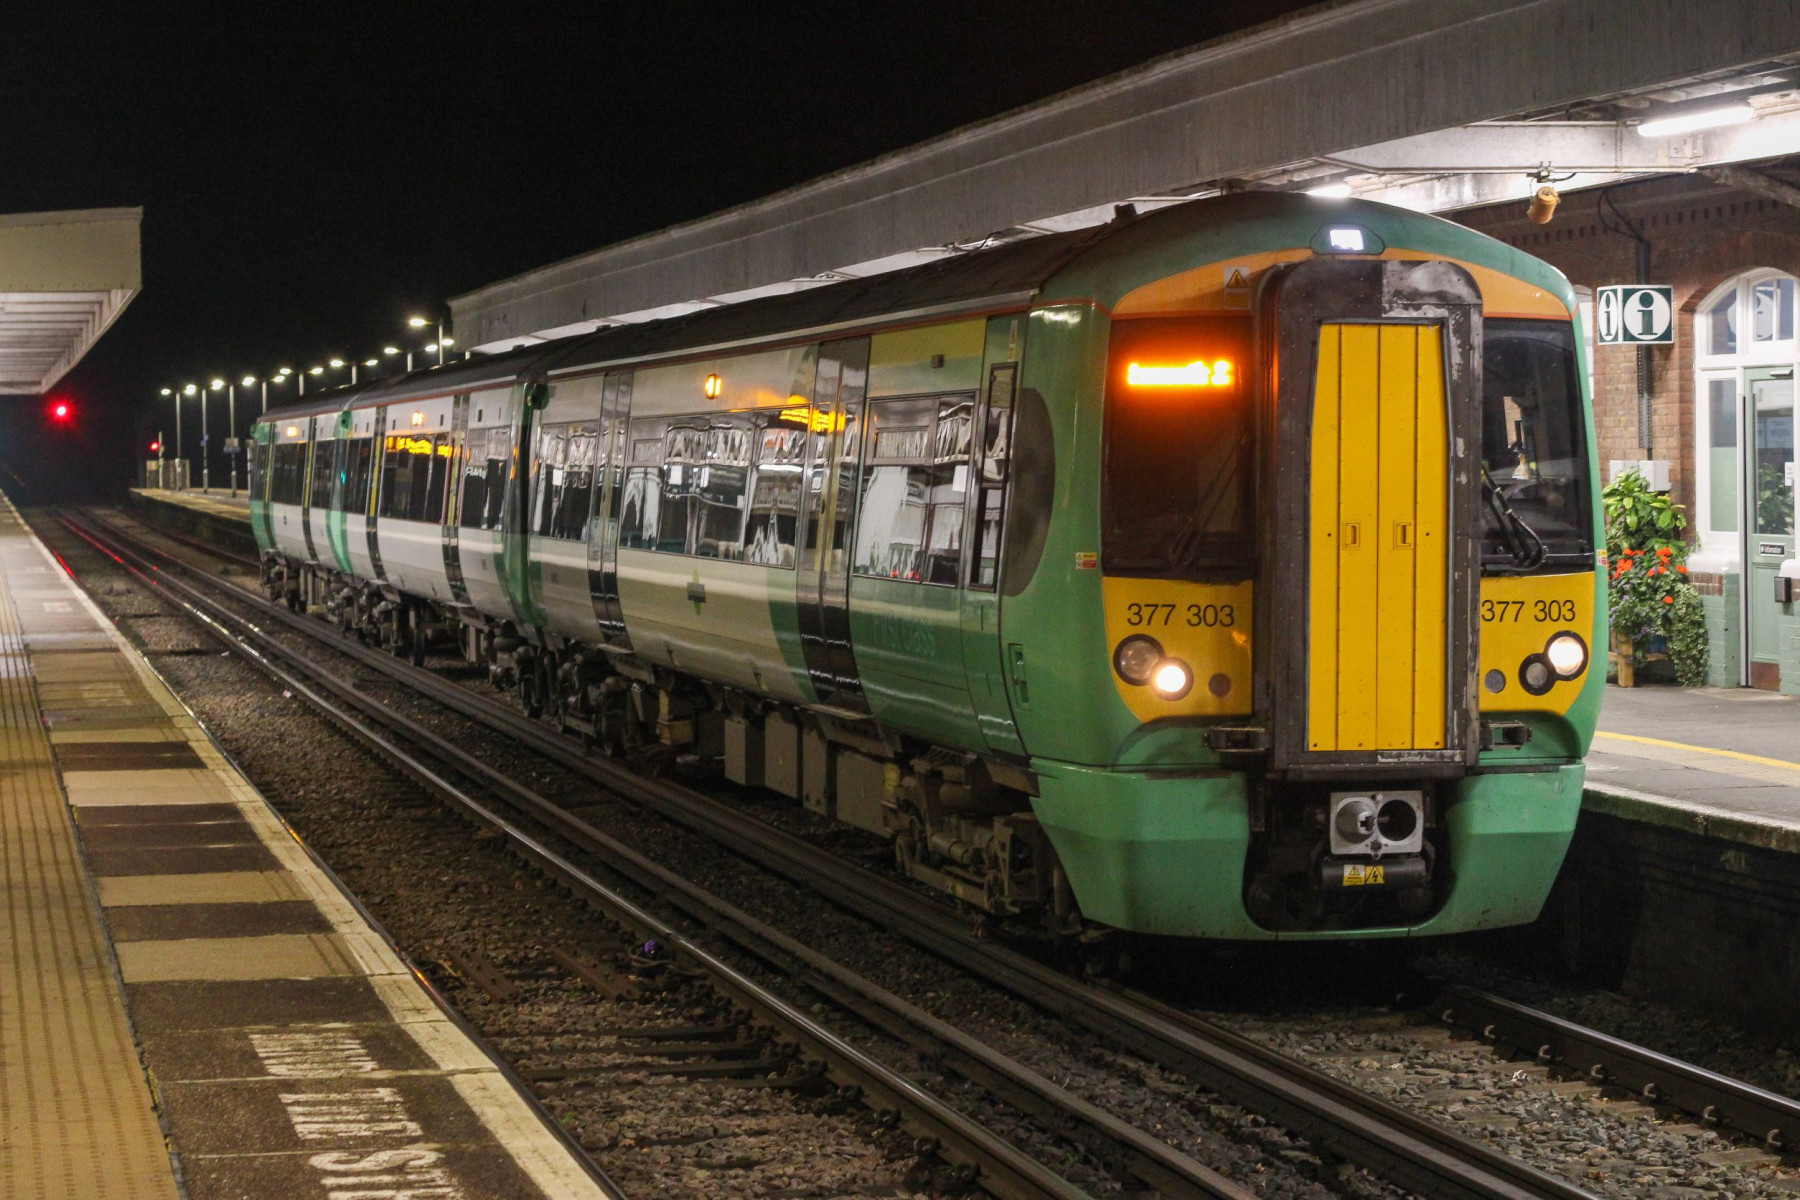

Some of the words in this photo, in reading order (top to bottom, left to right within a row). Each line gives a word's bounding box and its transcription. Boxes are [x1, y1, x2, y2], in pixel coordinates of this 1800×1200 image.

[1637, 291, 1658, 336] i
[1127, 603, 1176, 626] 377
[1186, 604, 1235, 627] 303
[1481, 599, 1525, 622] 377
[1534, 599, 1576, 622] 303
